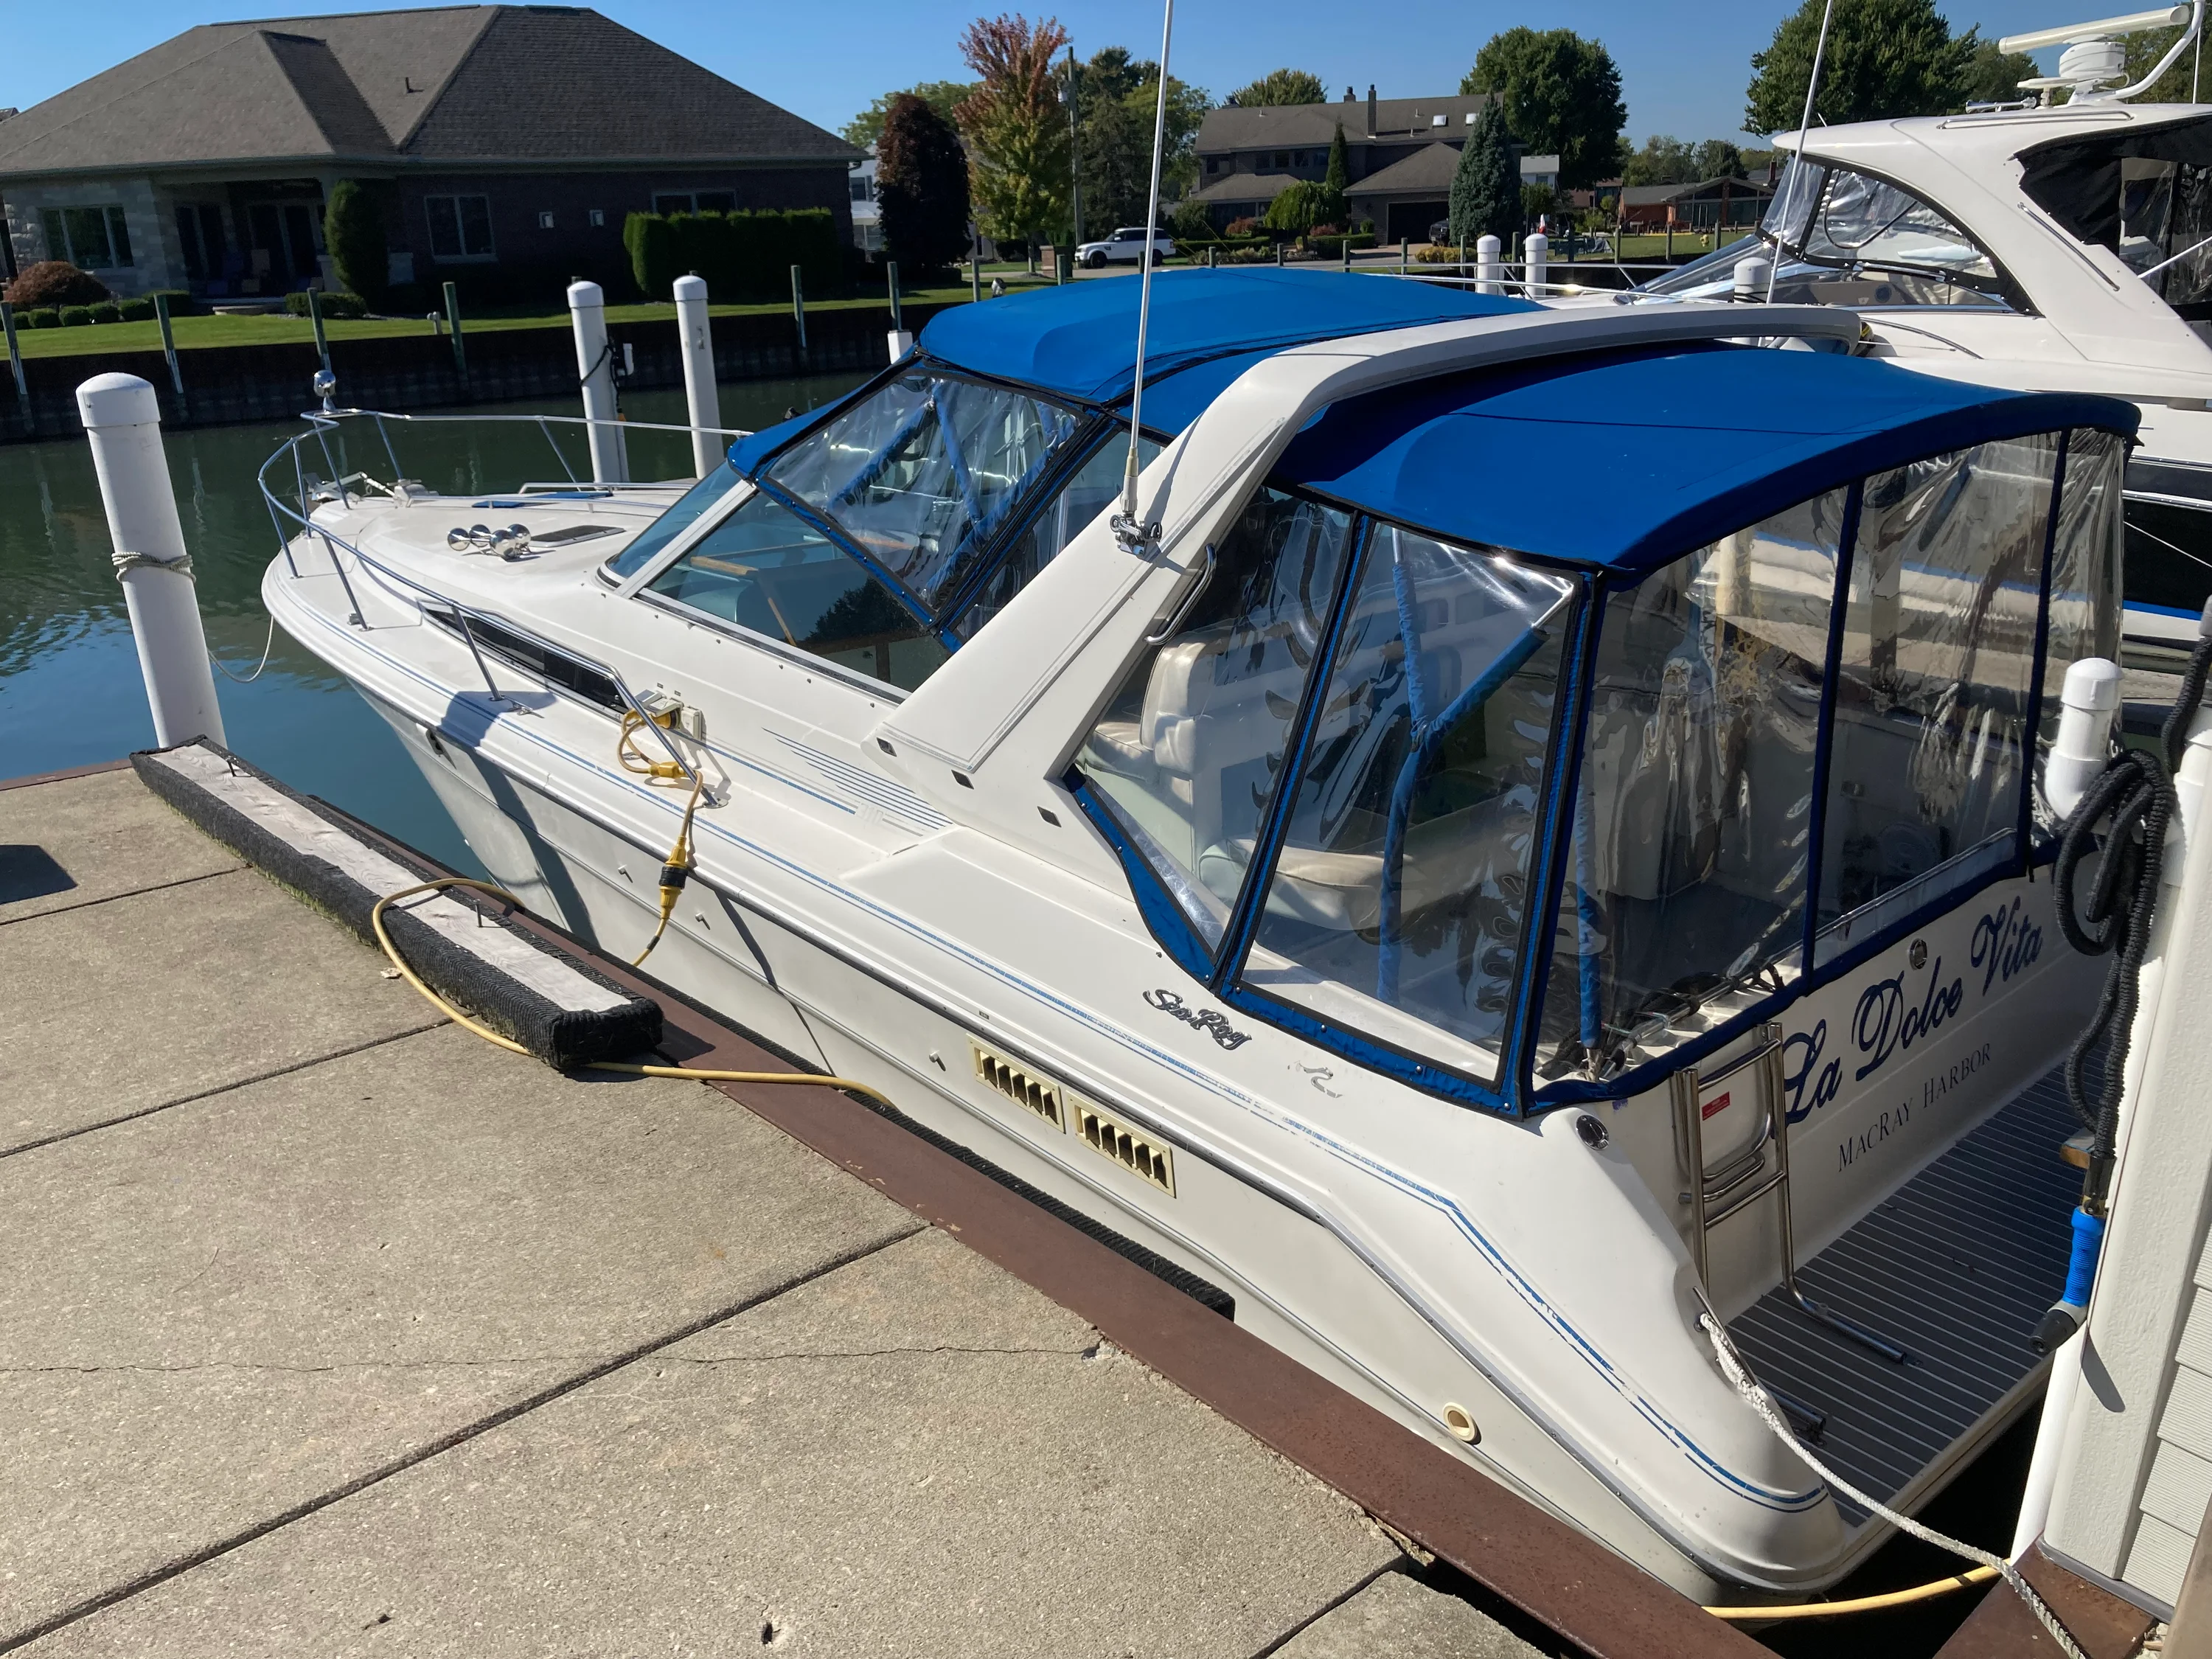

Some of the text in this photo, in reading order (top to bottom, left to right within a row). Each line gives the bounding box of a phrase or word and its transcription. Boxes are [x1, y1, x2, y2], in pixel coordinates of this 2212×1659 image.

[1781, 895, 2044, 1130] La Dolce Vita
[1923, 1043, 1991, 1108] HARBOR
